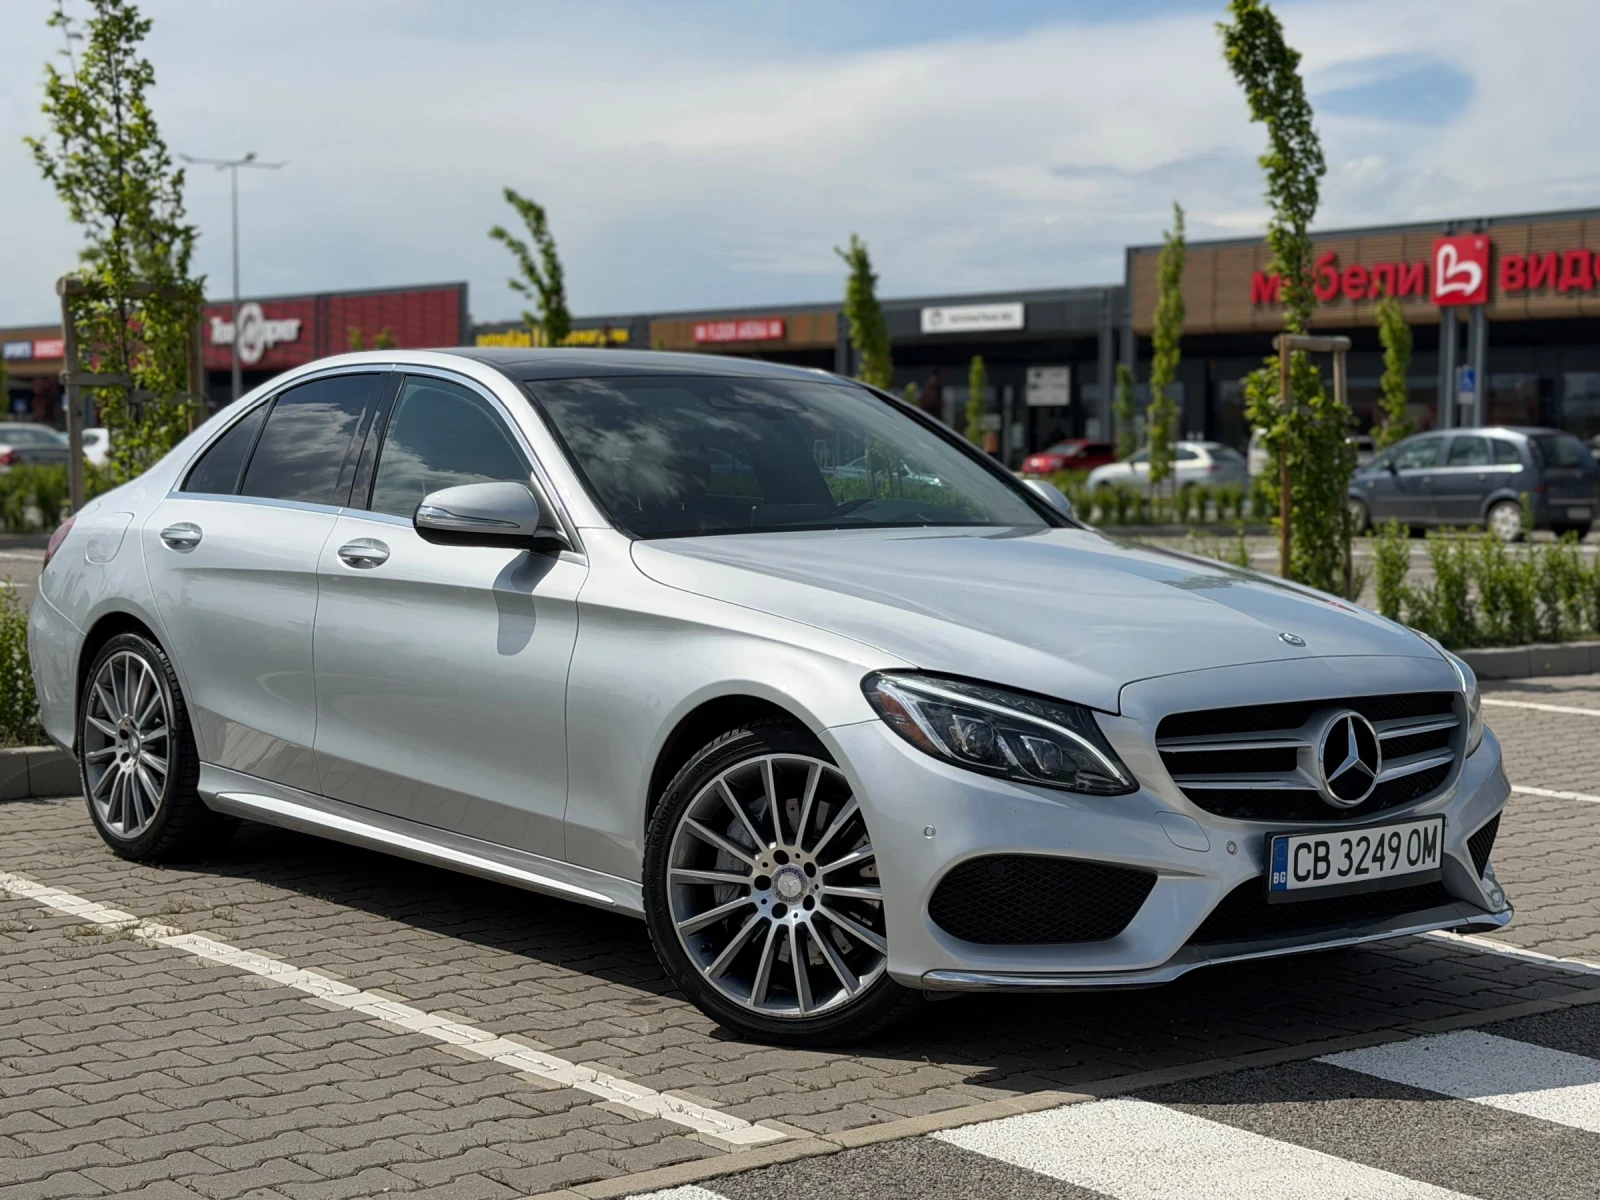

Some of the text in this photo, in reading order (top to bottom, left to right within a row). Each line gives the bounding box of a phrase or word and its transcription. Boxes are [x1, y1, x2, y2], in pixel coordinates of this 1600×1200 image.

[1251, 248, 1600, 304] мбели вид
[1273, 871, 1287, 884] BG
[1293, 825, 1438, 882] CB 3249 OM
